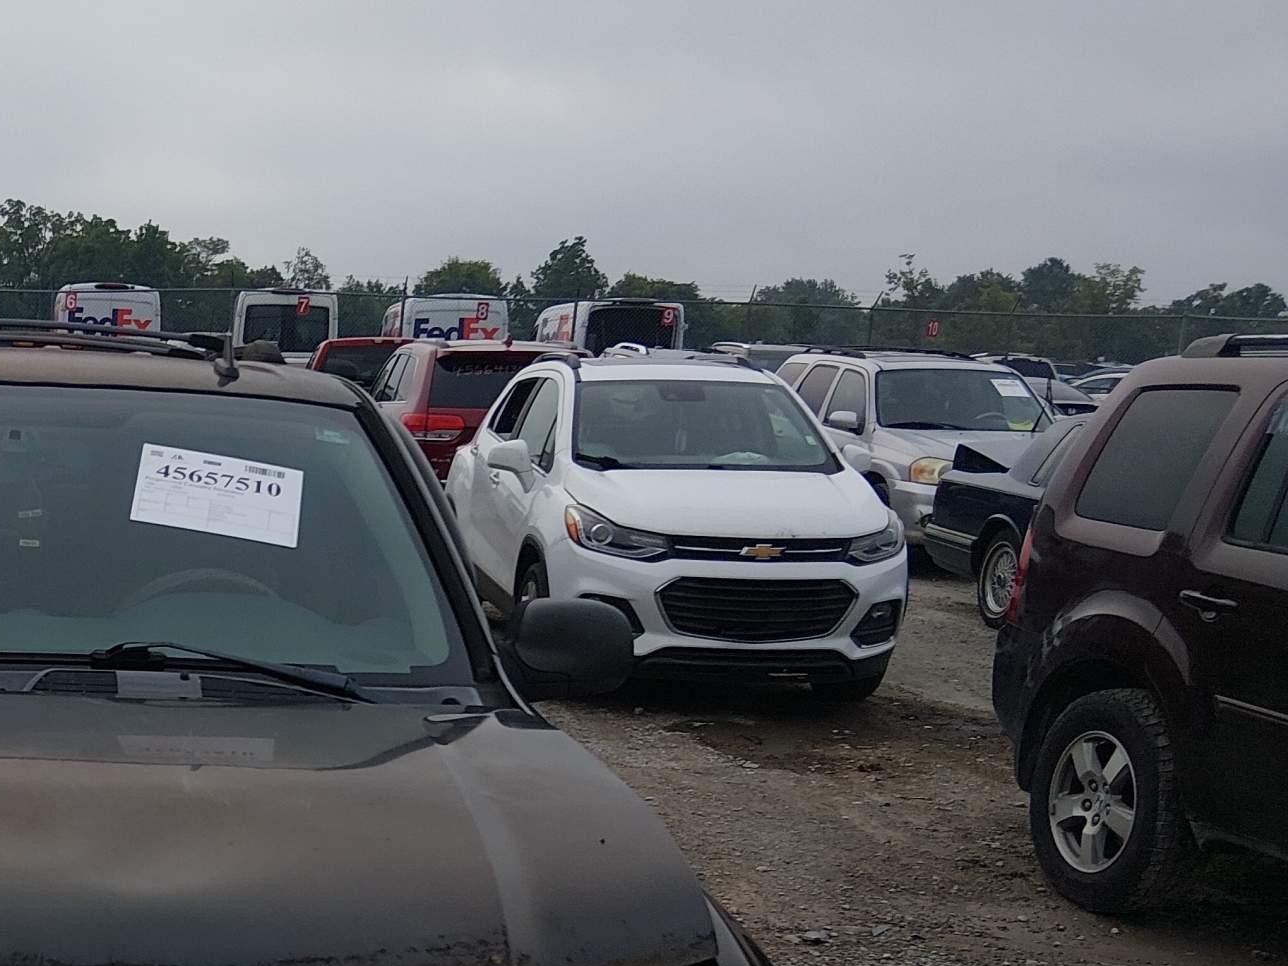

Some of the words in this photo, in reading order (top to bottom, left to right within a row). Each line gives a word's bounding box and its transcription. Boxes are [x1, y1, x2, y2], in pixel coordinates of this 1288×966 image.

[66, 294, 75, 308] 6
[299, 298, 309, 313] 7
[478, 303, 487, 318] 8
[664, 308, 674, 323] 9
[928, 321, 939, 335] 10
[156, 464, 282, 497] 45657510
